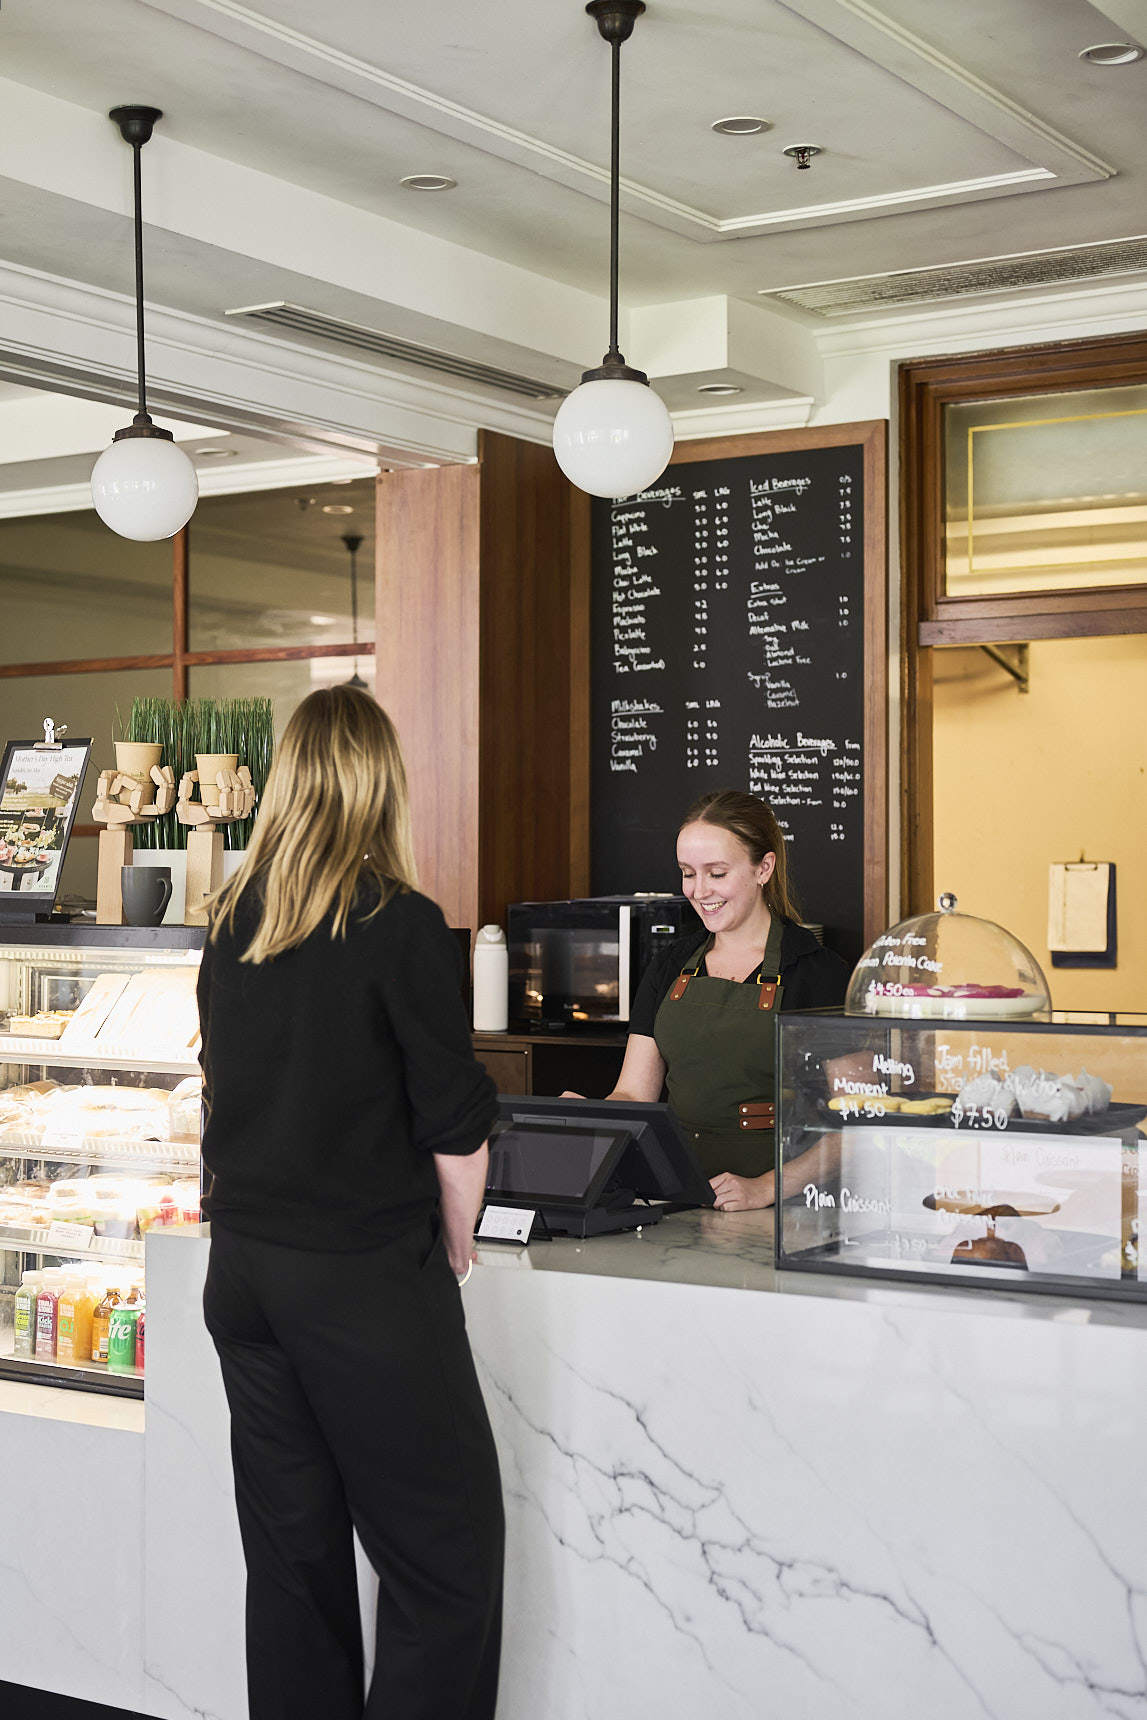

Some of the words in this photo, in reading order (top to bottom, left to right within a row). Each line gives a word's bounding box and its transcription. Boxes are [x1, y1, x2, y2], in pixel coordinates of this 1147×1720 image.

[749, 479, 770, 493] Iced
[751, 497, 773, 509] Latte
[752, 508, 773, 523] Long
[774, 503, 798, 515] Black
[612, 662, 630, 673] Tea
[611, 698, 662, 714] Milkshakes
[748, 732, 791, 749] Alcoholic
[49, 754, 63, 764] High
[64, 754, 73, 763] Tea
[902, 932, 927, 946] Free
[934, 1044, 964, 1070] Jam
[872, 1053, 915, 1086] Melting
[833, 1077, 889, 1098] Moment
[951, 1096, 1008, 1130] $7.50
[803, 1183, 836, 1212] Plain
[60, 1319, 74, 1333] OJ
[108, 1318, 132, 1340] ite
